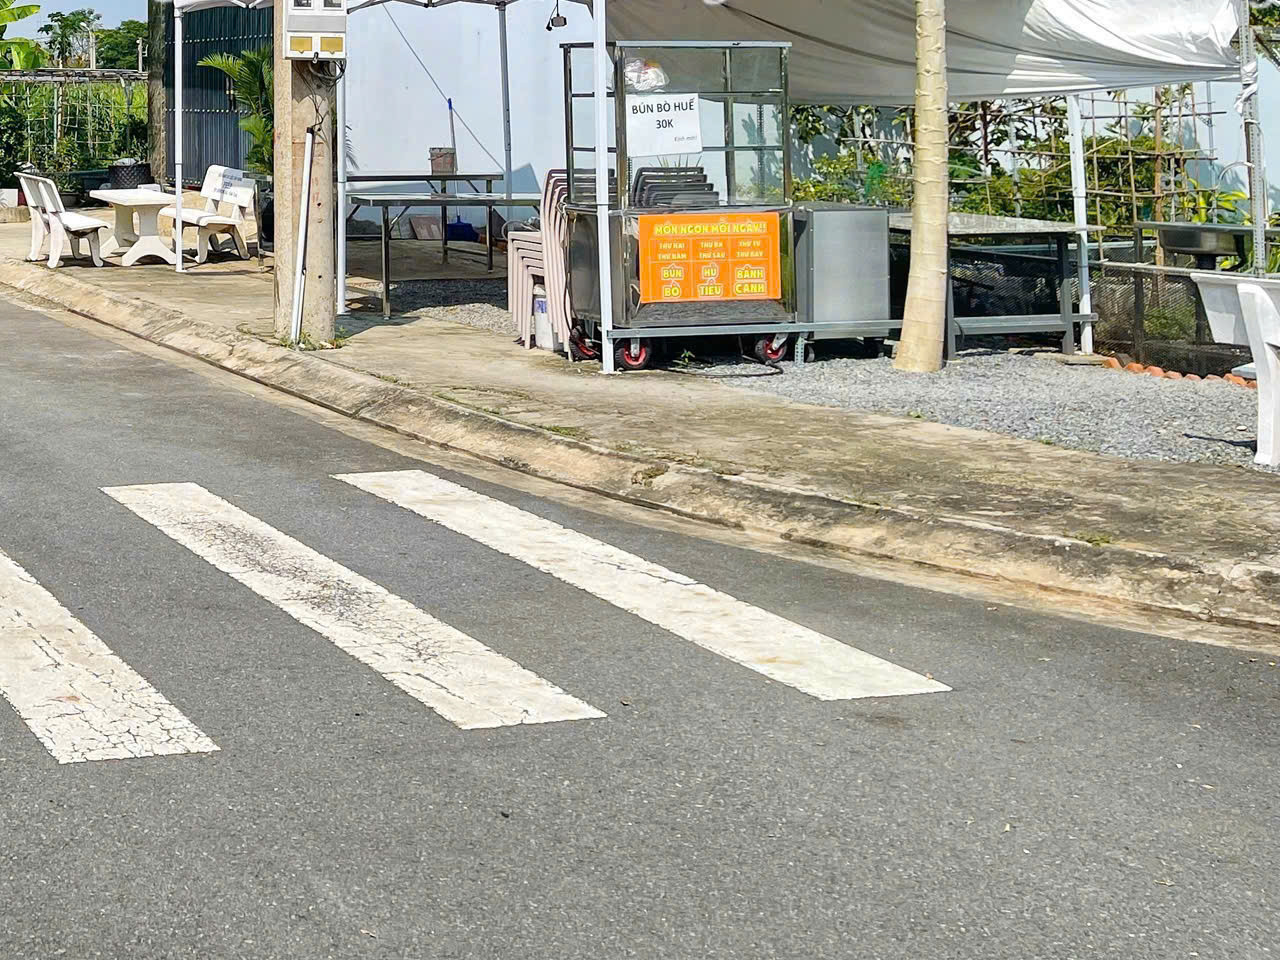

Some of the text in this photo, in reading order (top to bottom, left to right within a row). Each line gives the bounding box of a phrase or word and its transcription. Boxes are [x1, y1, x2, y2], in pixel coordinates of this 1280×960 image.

[631, 97, 696, 115] BÚN BÒ HUẾ
[655, 119, 674, 129] 30K
[734, 283, 765, 294] CANH
